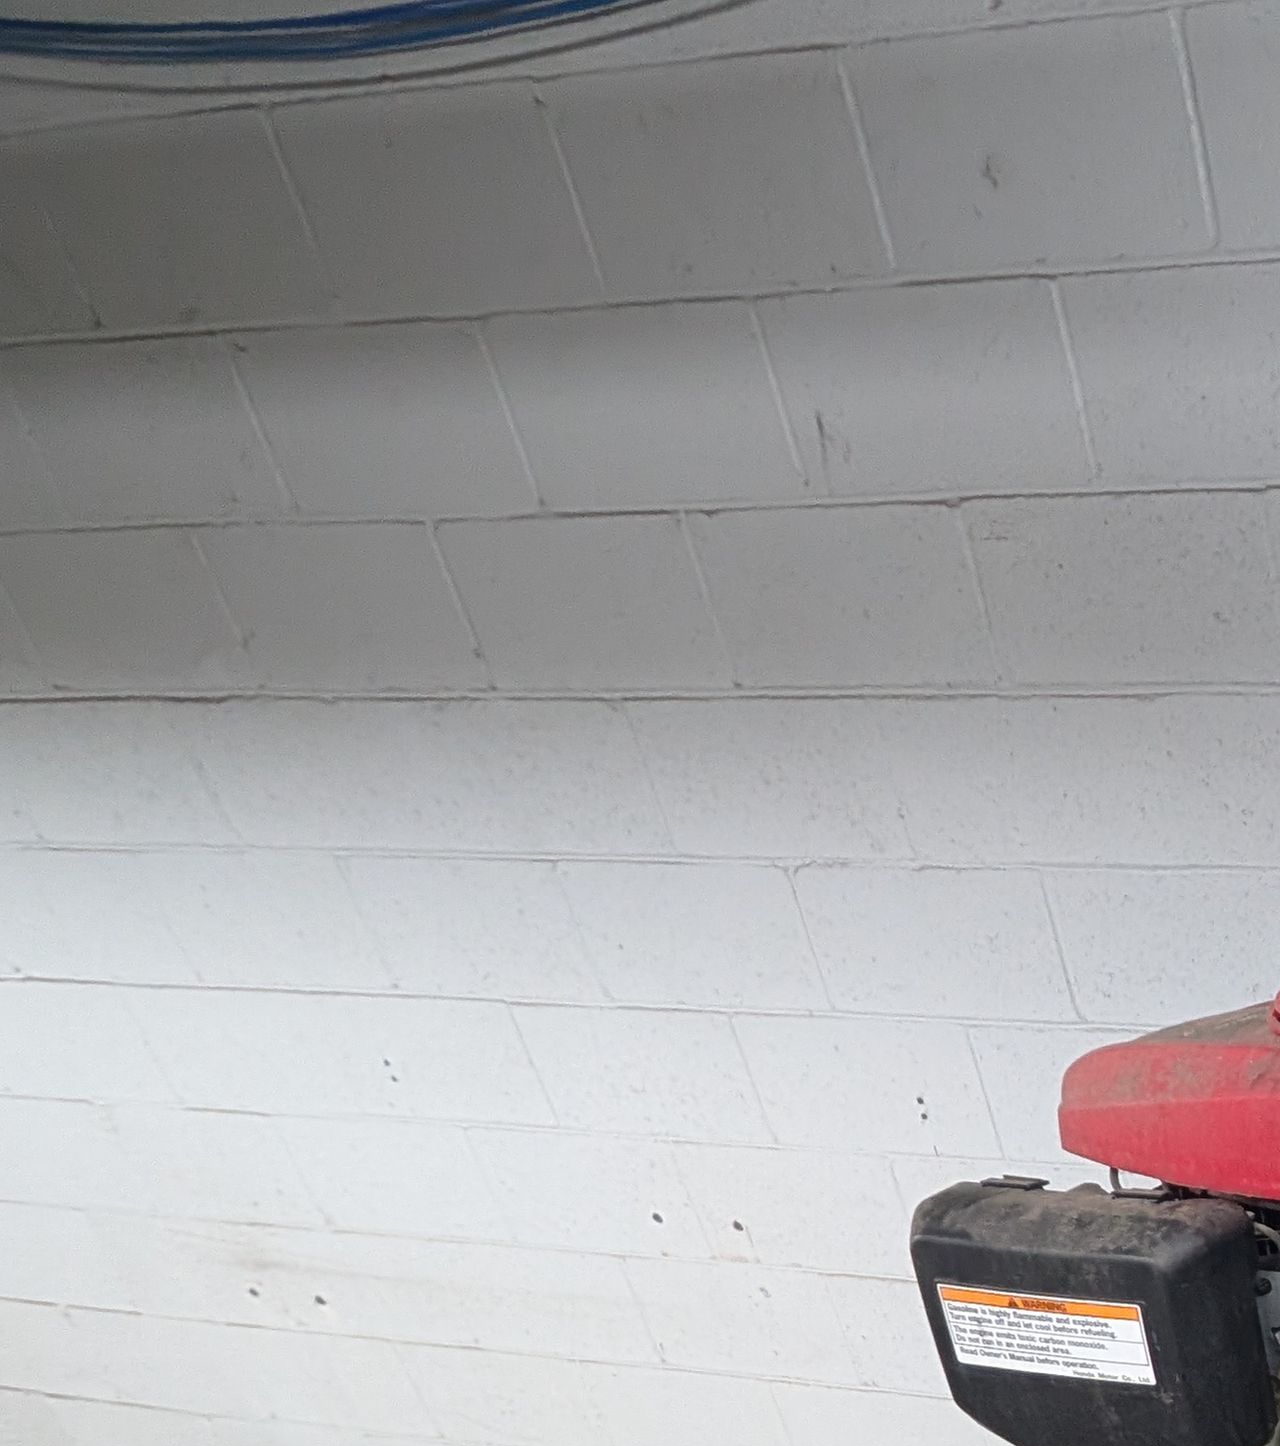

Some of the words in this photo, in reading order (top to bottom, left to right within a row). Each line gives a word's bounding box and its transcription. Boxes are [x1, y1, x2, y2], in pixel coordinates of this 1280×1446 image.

[947, 1303, 978, 1313] Gasoline
[988, 1308, 1010, 1318] highly
[1013, 1311, 1053, 1322] flammable
[1021, 1299, 1067, 1312] WARNING
[950, 1312, 966, 1321] Turn
[968, 1316, 992, 1324] engine
[1023, 1321, 1033, 1329] let
[1053, 1324, 1078, 1334] before
[1081, 1329, 1118, 1339] refueling.
[953, 1325, 967, 1333] The
[969, 1328, 994, 1337] engine
[996, 1331, 1016, 1340] emits
[1018, 1334, 1037, 1342] toxic
[1039, 1336, 1065, 1345] carbon
[1068, 1341, 1108, 1350] monoxide.
[956, 1334, 966, 1342] Do
[1017, 1342, 1050, 1352] enclosed
[1053, 1347, 1072, 1355] area.
[960, 1346, 978, 1355] Read
[980, 1348, 1007, 1359] Owner's
[1009, 1353, 1035, 1362] Manual
[1037, 1356, 1060, 1366] before
[1062, 1361, 1099, 1370] operation.
